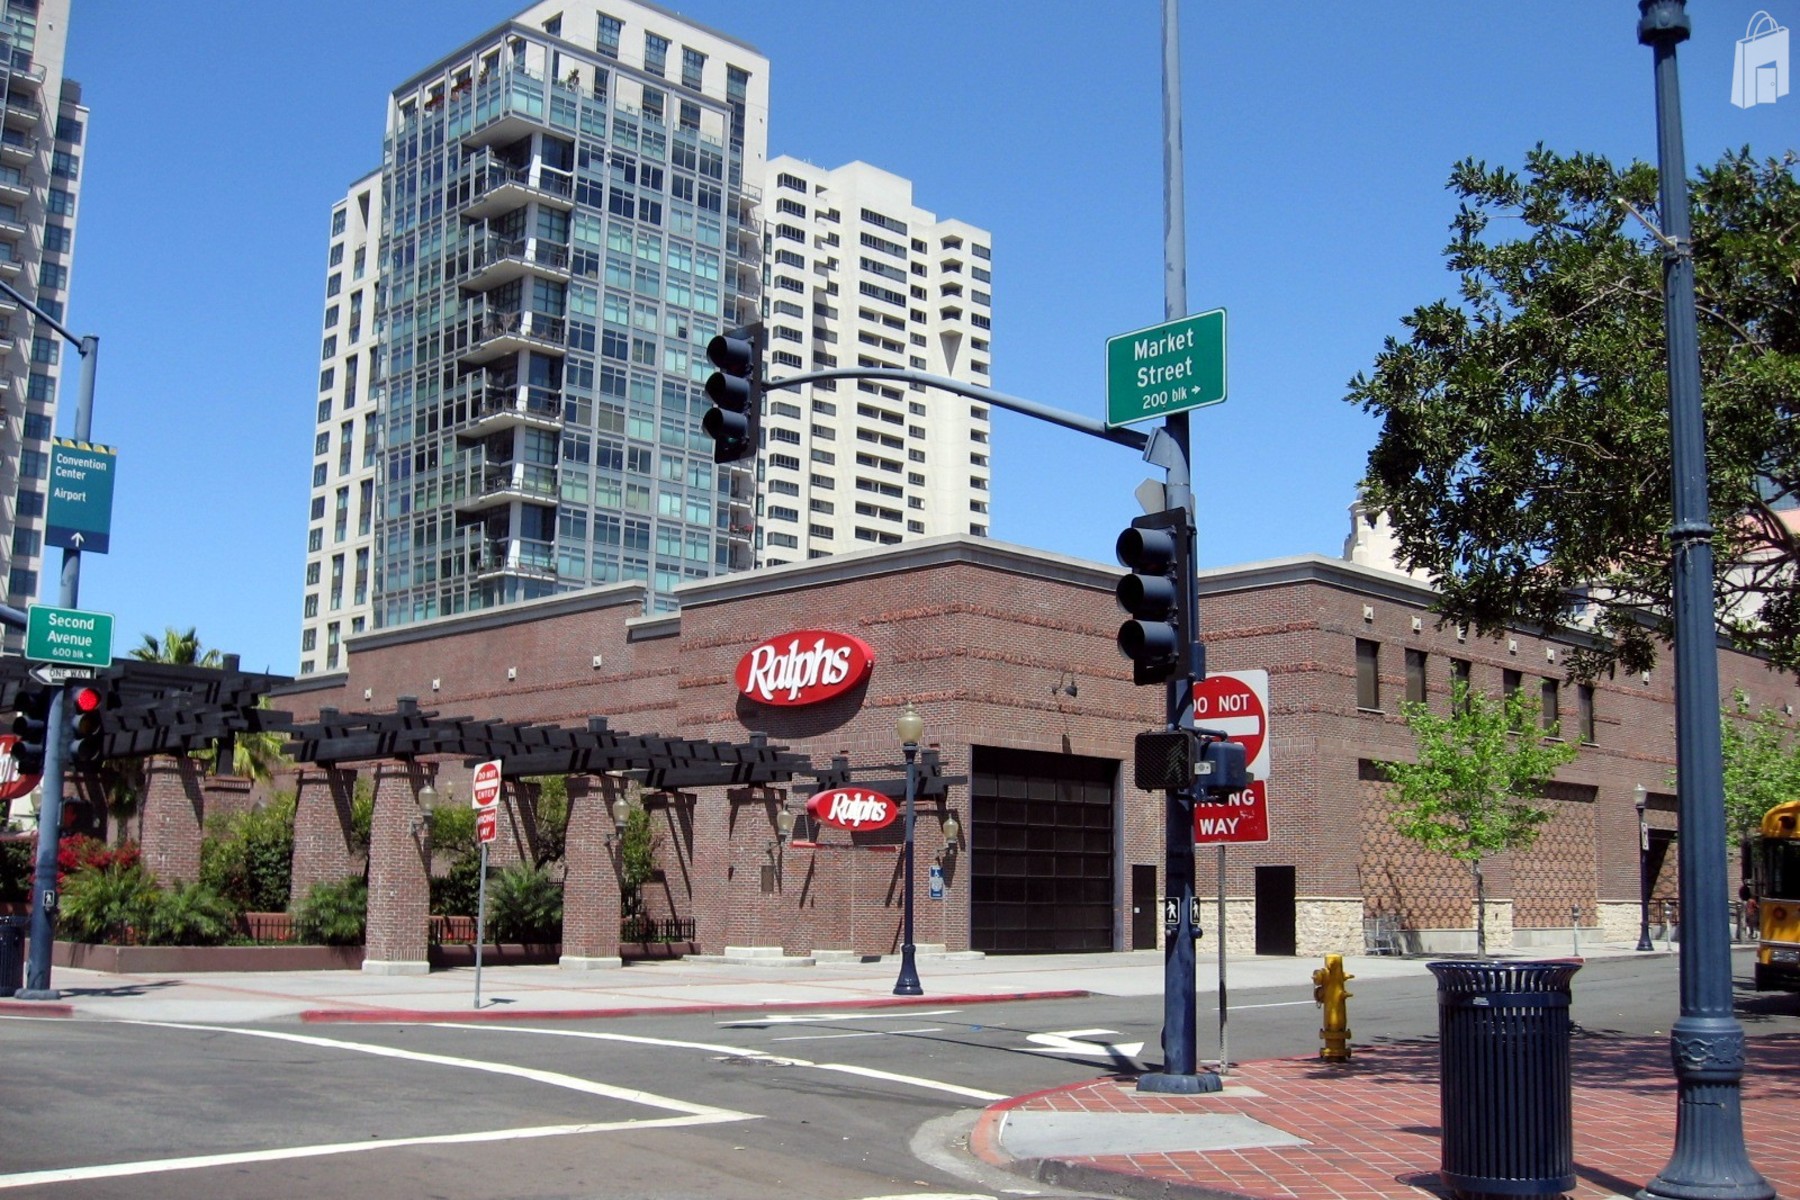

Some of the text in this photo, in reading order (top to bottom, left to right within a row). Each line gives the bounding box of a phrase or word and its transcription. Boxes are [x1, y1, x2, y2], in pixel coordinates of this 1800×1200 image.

[1134, 328, 1194, 361] Market
[1137, 356, 1192, 388] Street
[1142, 386, 1187, 410] 200 blk
[56, 453, 107, 471] Convention
[55, 466, 87, 480] Center
[53, 487, 87, 502] Airport
[48, 613, 95, 631] Second
[47, 630, 93, 647] Avenue
[52, 647, 71, 657] 600
[49, 668, 88, 679] ONE WAY
[745, 638, 851, 701] Ralphs
[1218, 694, 1250, 713] NOT
[478, 770, 496, 780] DO NOT
[477, 788, 495, 800] ENTER
[827, 792, 887, 827] Ralphs
[1199, 817, 1240, 836] WAY
